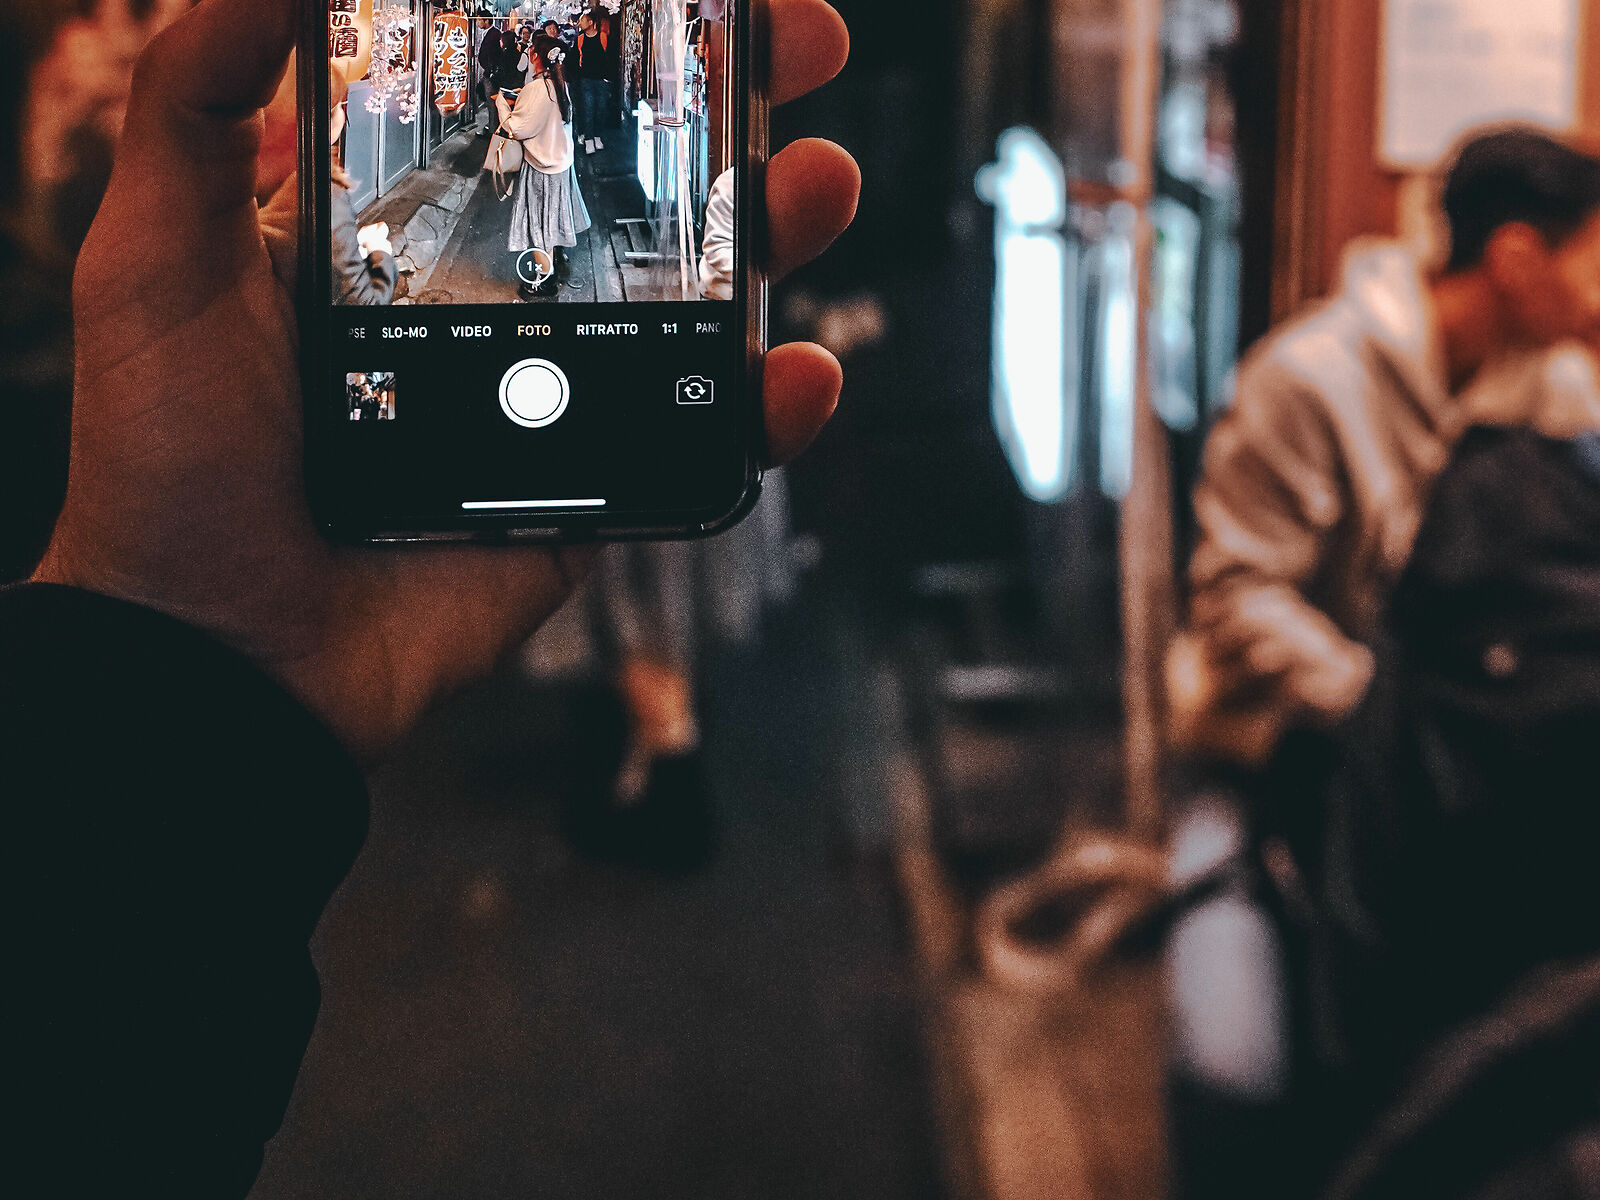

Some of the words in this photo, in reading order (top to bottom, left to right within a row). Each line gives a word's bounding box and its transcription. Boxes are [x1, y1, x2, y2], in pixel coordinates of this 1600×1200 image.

[381, 326, 428, 339] SLO-MO
[450, 325, 492, 338] VIDEO
[517, 324, 552, 337] FOTO
[576, 323, 639, 336] RITRATTO
[661, 322, 679, 335] 1:1
